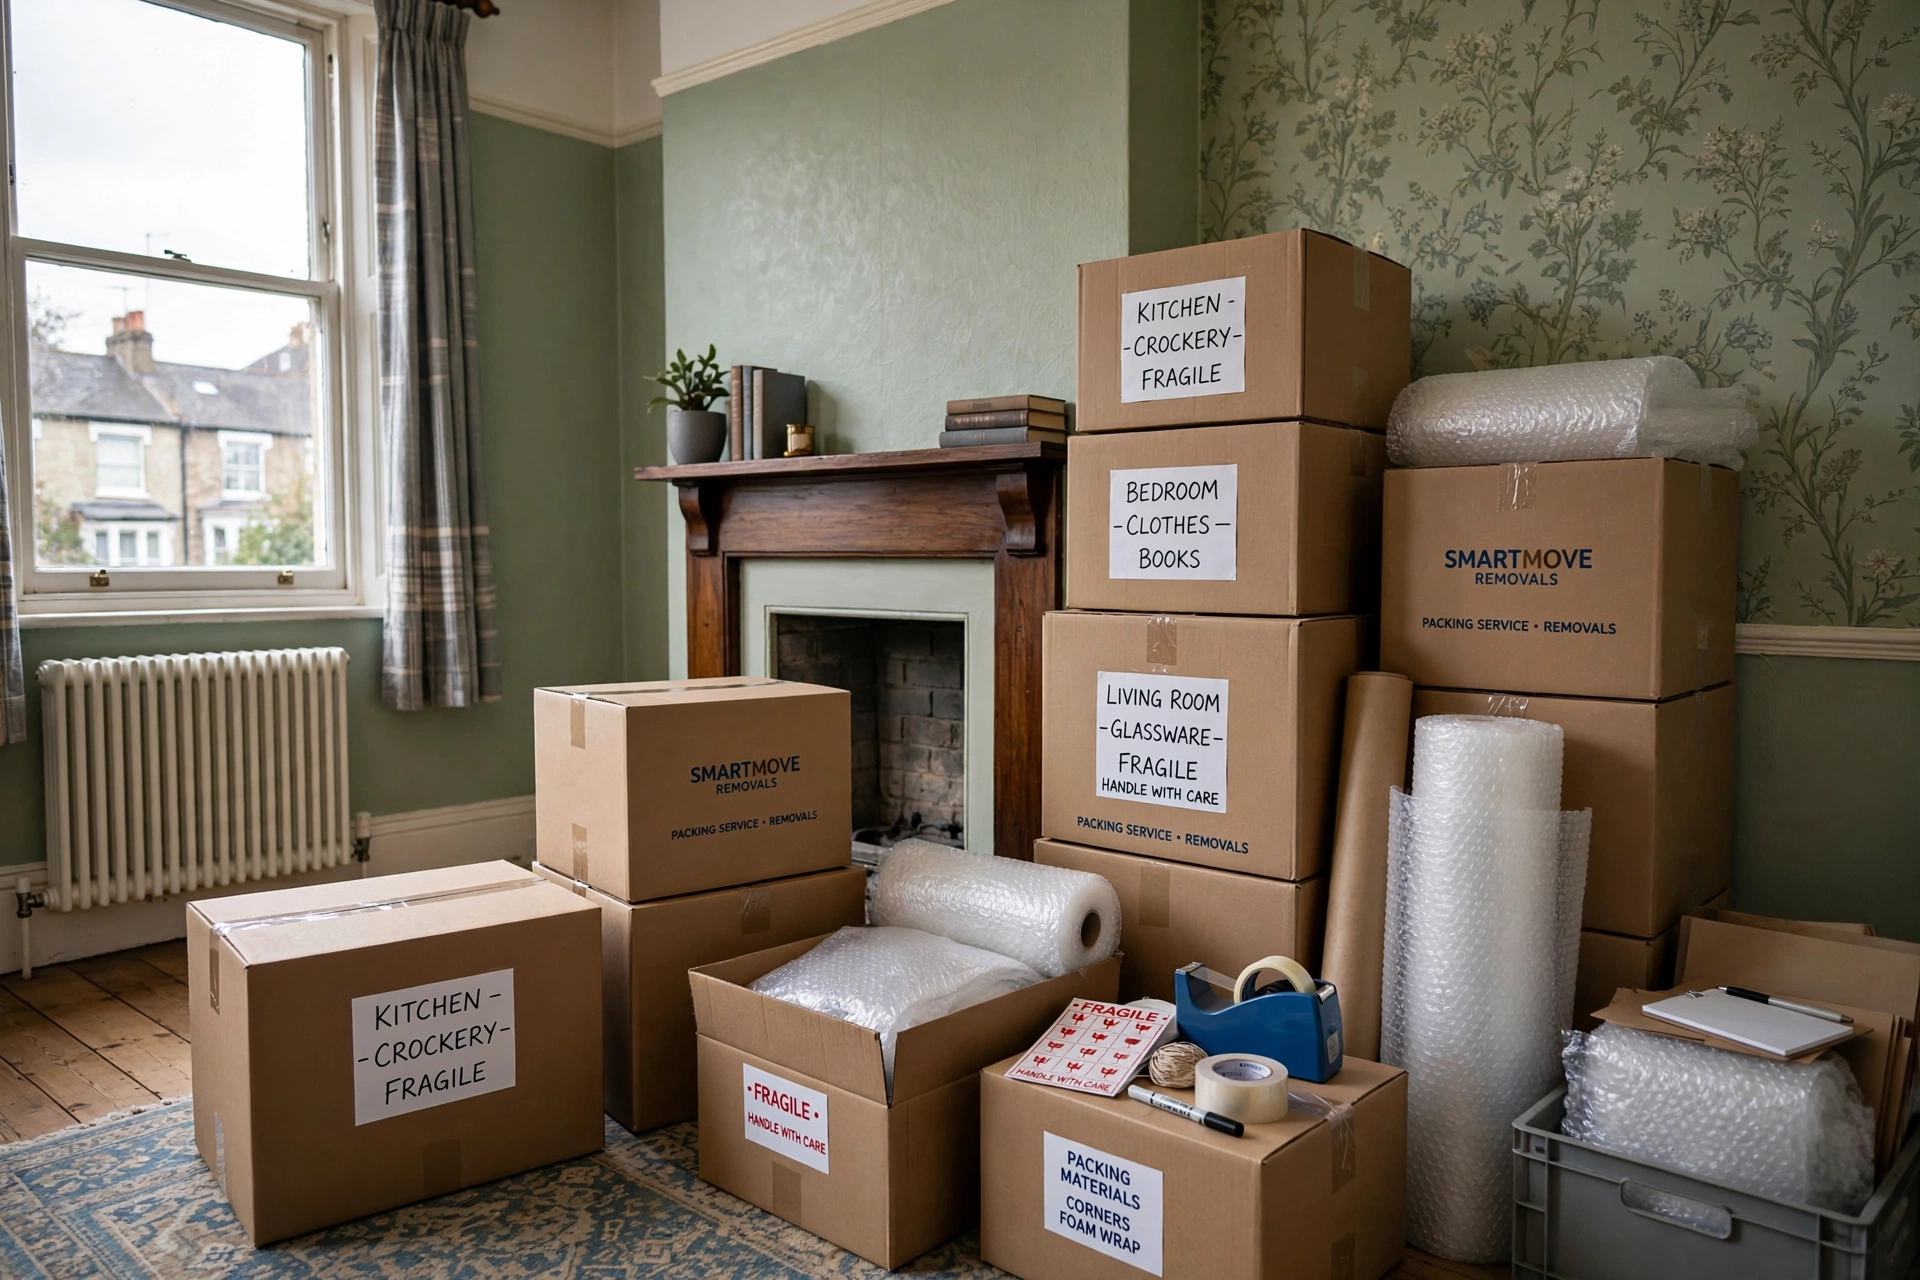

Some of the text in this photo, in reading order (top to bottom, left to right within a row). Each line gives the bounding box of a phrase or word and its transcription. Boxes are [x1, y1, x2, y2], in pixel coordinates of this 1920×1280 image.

[1138, 293, 1221, 324] KITCHEN
[1142, 363, 1221, 391] FRAGILE
[1126, 479, 1218, 503] BEDROOM
[1139, 547, 1200, 569] BOOKS
[1444, 548, 1593, 569] SMARTMOVE
[1475, 572, 1558, 586] REMOVALS
[1422, 617, 1617, 635] PACKING SERVICE REMOVALS
[1106, 684, 1220, 713] LIVING ROOM
[690, 755, 800, 784] SMARTMOVE
[1119, 752, 1198, 780] FRAGILE
[716, 777, 778, 795] REMOVALS
[1102, 777, 1219, 806] HANDLE WITH CARE
[671, 810, 818, 840] PACKING SERVICE REMOVALS
[1077, 816, 1249, 854] PACKING SERVICE REMOVALS
[375, 988, 481, 1031] KITCHEN
[1080, 1002, 1160, 1023] FRAGILE
[385, 1060, 486, 1105] FRAGILE
[1015, 1068, 1112, 1092] HANDLE WITH CARE
[754, 1082, 811, 1121] FRAGILE
[747, 1111, 826, 1155] HANDLE WITH CARE
[1067, 1150, 1131, 1186] PACKING
[1060, 1167, 1141, 1210] MATERIALS
[1066, 1195, 1131, 1232] CORNERS
[1060, 1210, 1141, 1254] FOAM WRAP
